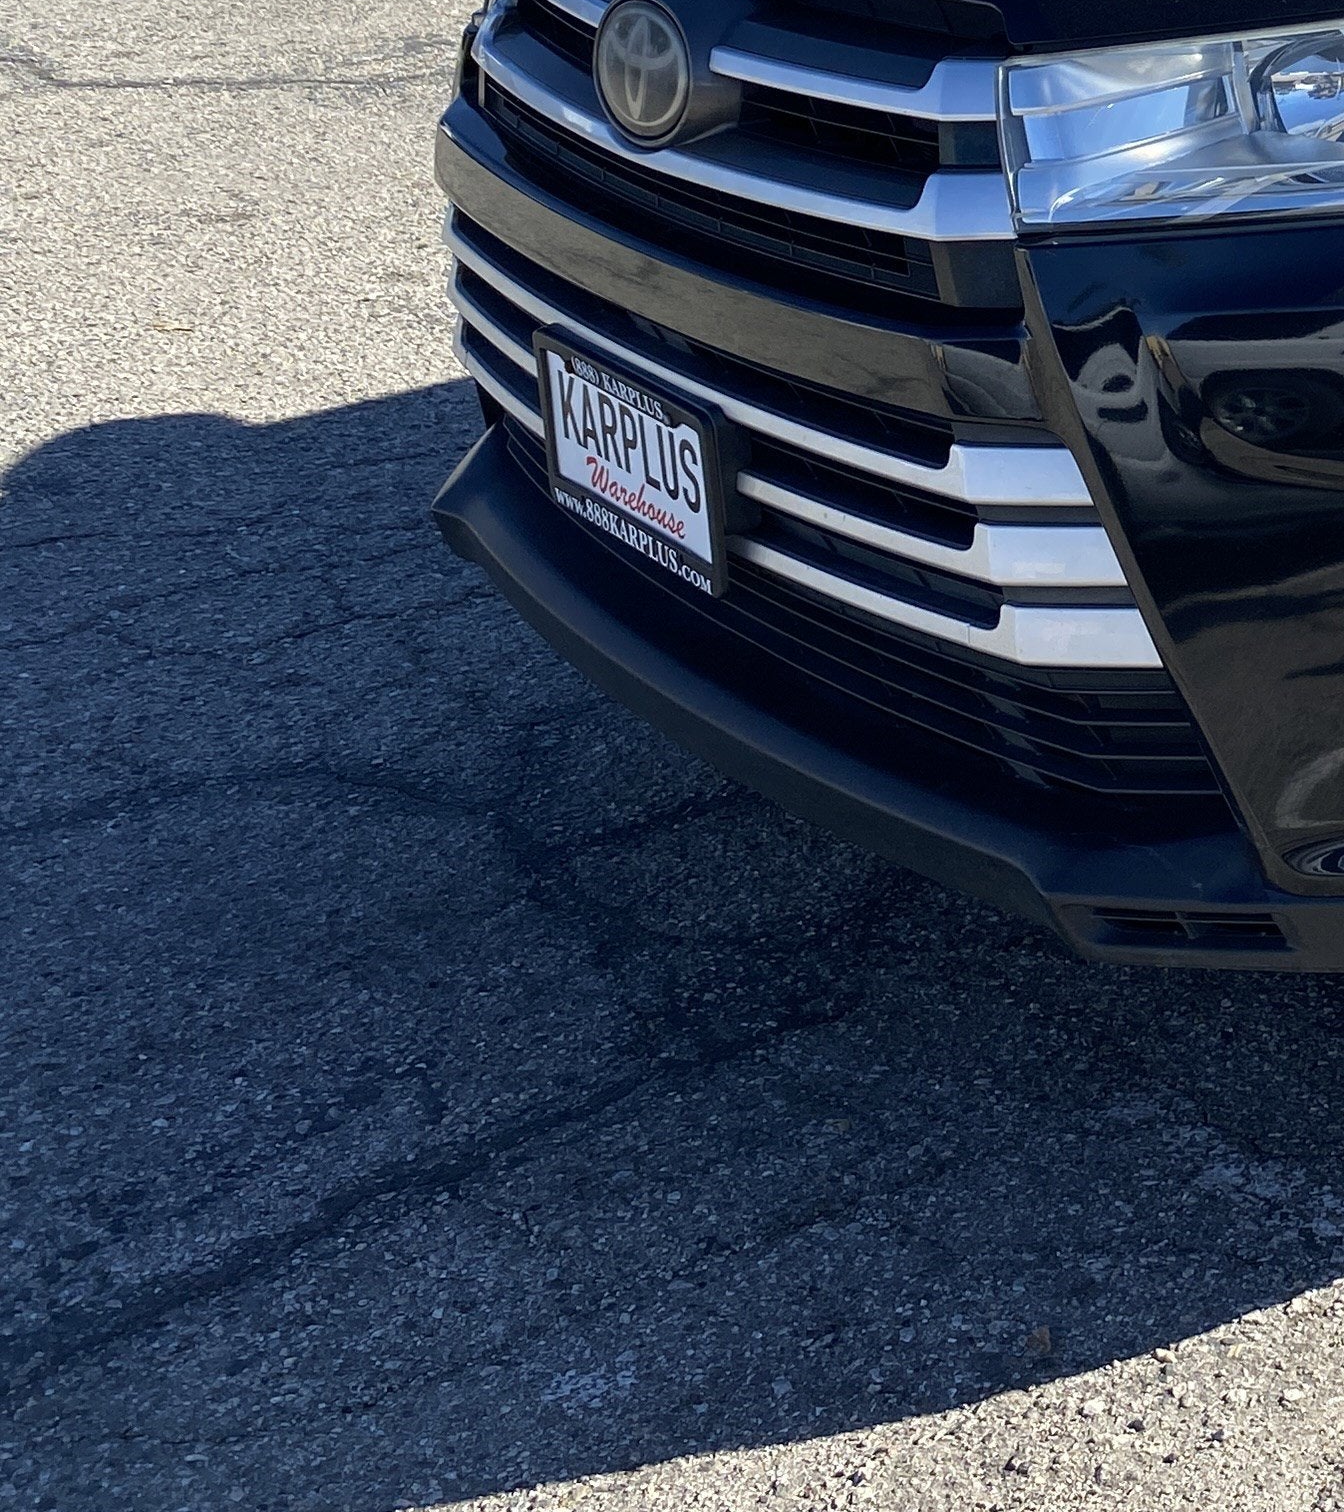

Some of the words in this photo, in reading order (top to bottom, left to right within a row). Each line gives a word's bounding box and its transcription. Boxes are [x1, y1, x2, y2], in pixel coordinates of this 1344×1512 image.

[570, 355, 601, 386] (888)
[601, 371, 664, 420] KARPLUS
[557, 369, 702, 514] KARPLUS
[586, 455, 686, 539] Warehouse
